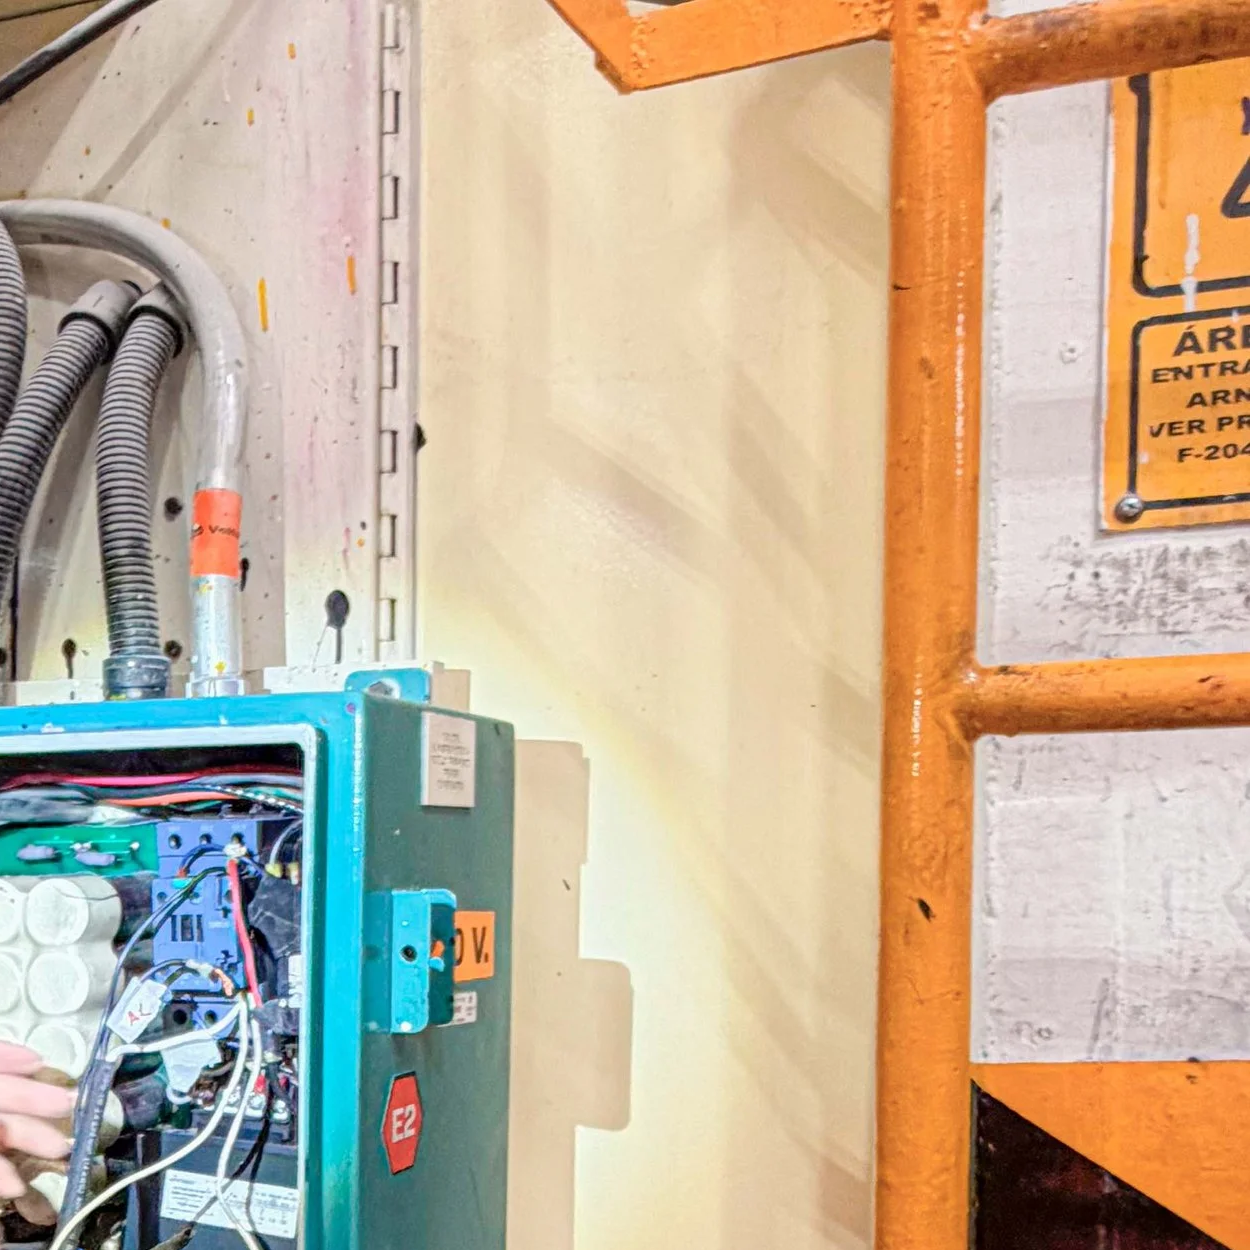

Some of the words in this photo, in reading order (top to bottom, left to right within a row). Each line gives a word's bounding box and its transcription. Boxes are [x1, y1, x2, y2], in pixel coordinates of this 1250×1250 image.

[1150, 419, 1206, 438] VER
[472, 926, 489, 964] V.
[391, 1104, 417, 1144] E2
